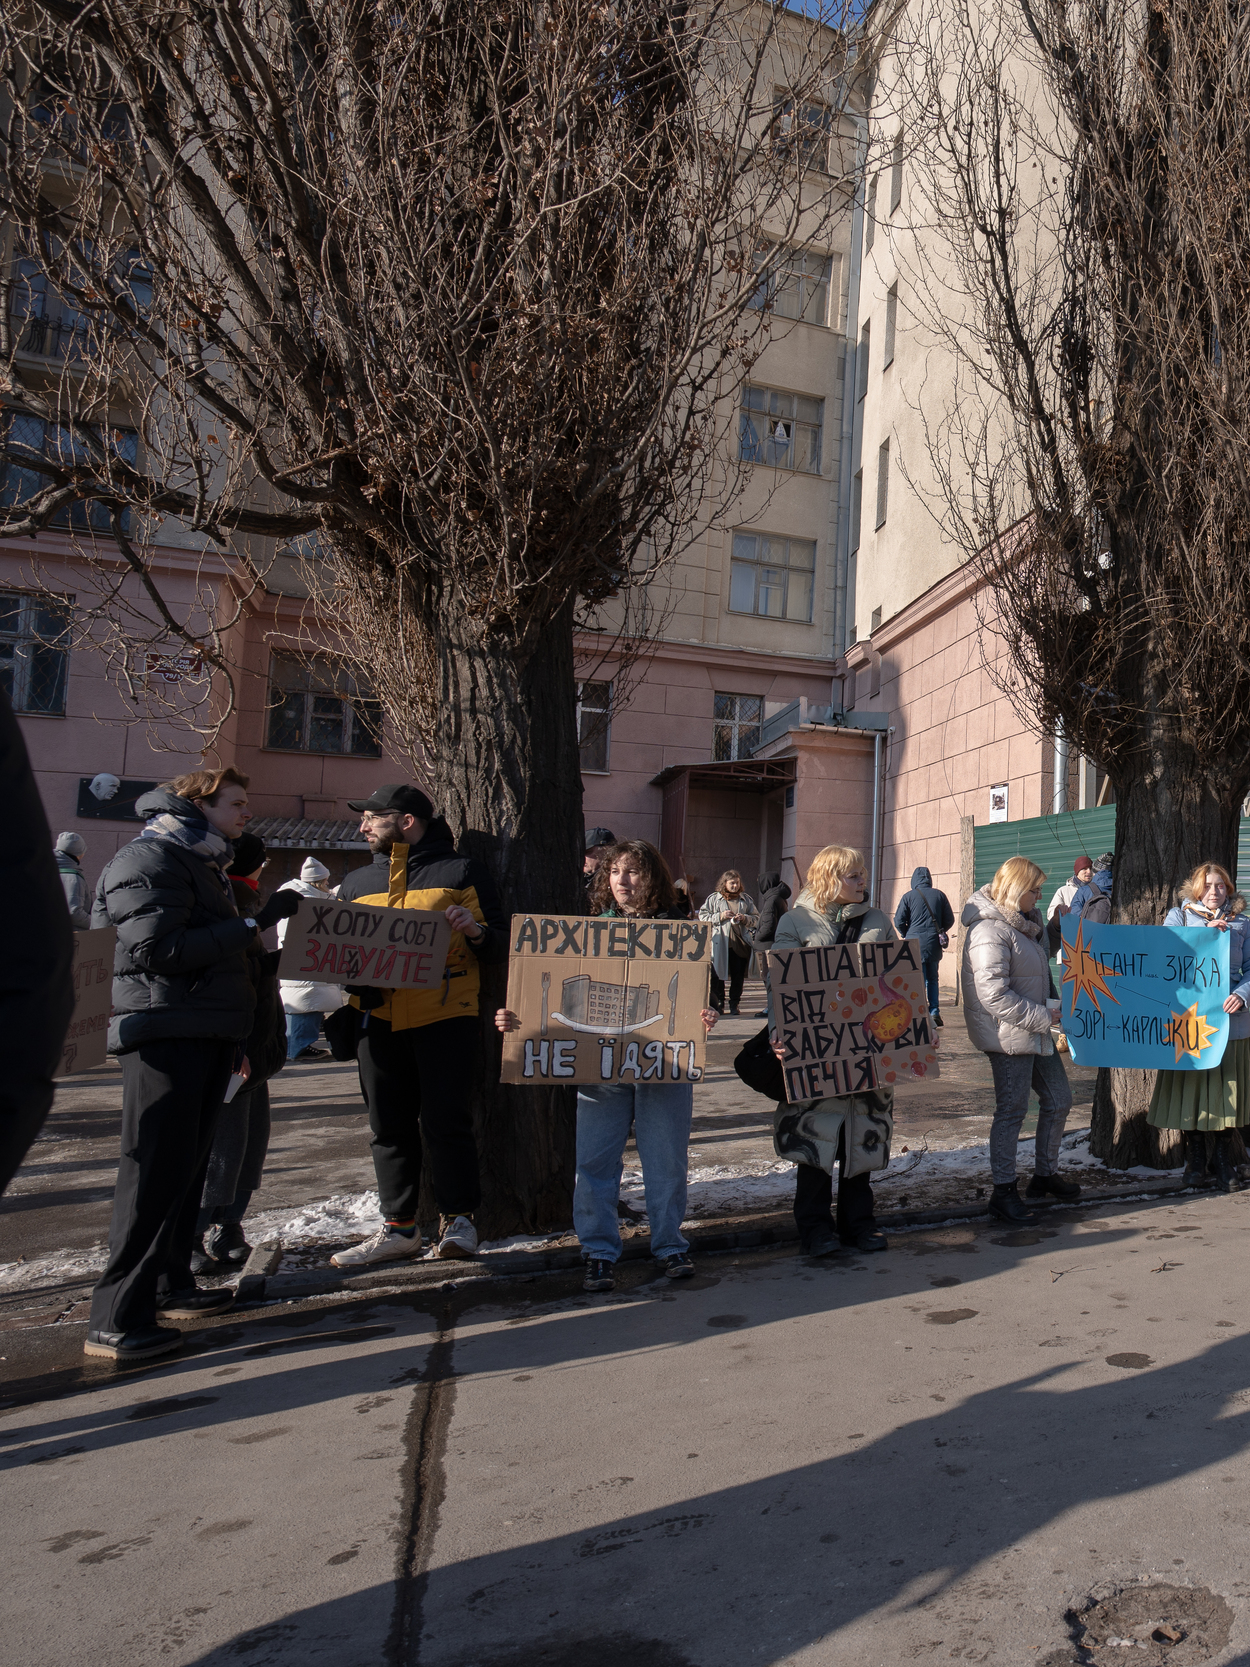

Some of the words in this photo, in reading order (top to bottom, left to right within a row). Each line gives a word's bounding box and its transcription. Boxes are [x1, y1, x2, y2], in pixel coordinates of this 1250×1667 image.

[306, 906, 384, 938] ЖОПУ
[388, 918, 438, 947] СОБІ
[515, 917, 708, 961] АРХІТЕКТУРУ
[70, 958, 109, 990] ИТЬ
[773, 952, 793, 984] У
[1081, 950, 1148, 977] ГІГАНТ
[1163, 955, 1221, 987] ЗІРКА
[67, 1013, 106, 1040] ЖЕМО
[779, 989, 826, 1025] ВІД
[1074, 1008, 1106, 1040] ЗОРІ
[1122, 1014, 1200, 1050] КАРЛИКИ
[523, 1039, 577, 1078] НЕ
[597, 1038, 703, 1081] ЇДЯТЬ
[785, 1056, 876, 1101] ПЕЧІЯ
